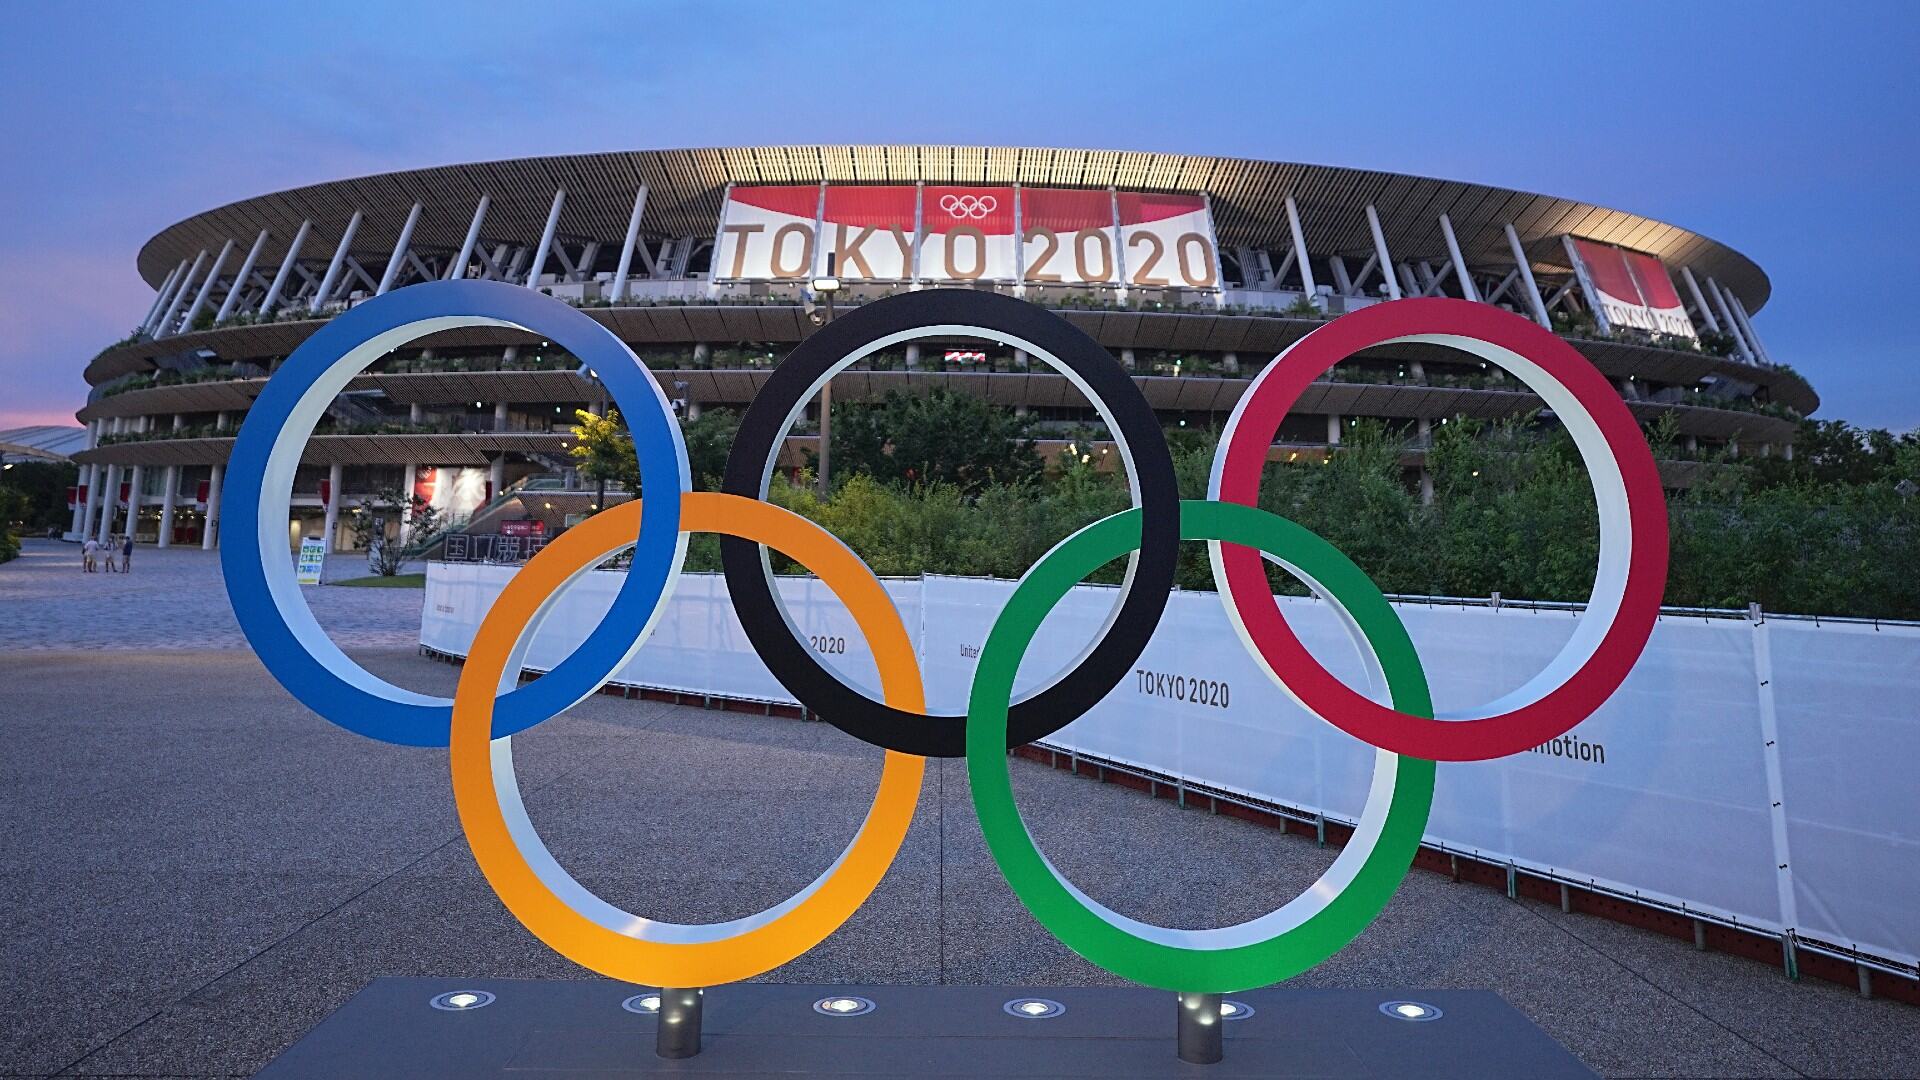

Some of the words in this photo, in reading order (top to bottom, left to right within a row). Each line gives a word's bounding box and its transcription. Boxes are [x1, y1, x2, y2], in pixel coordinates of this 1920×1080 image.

[722, 222, 987, 280] TOKYO
[1022, 226, 1218, 287] 2020
[810, 635, 845, 655] 2020
[1136, 669, 1185, 701] TOKYO
[1189, 677, 1229, 709] 2020
